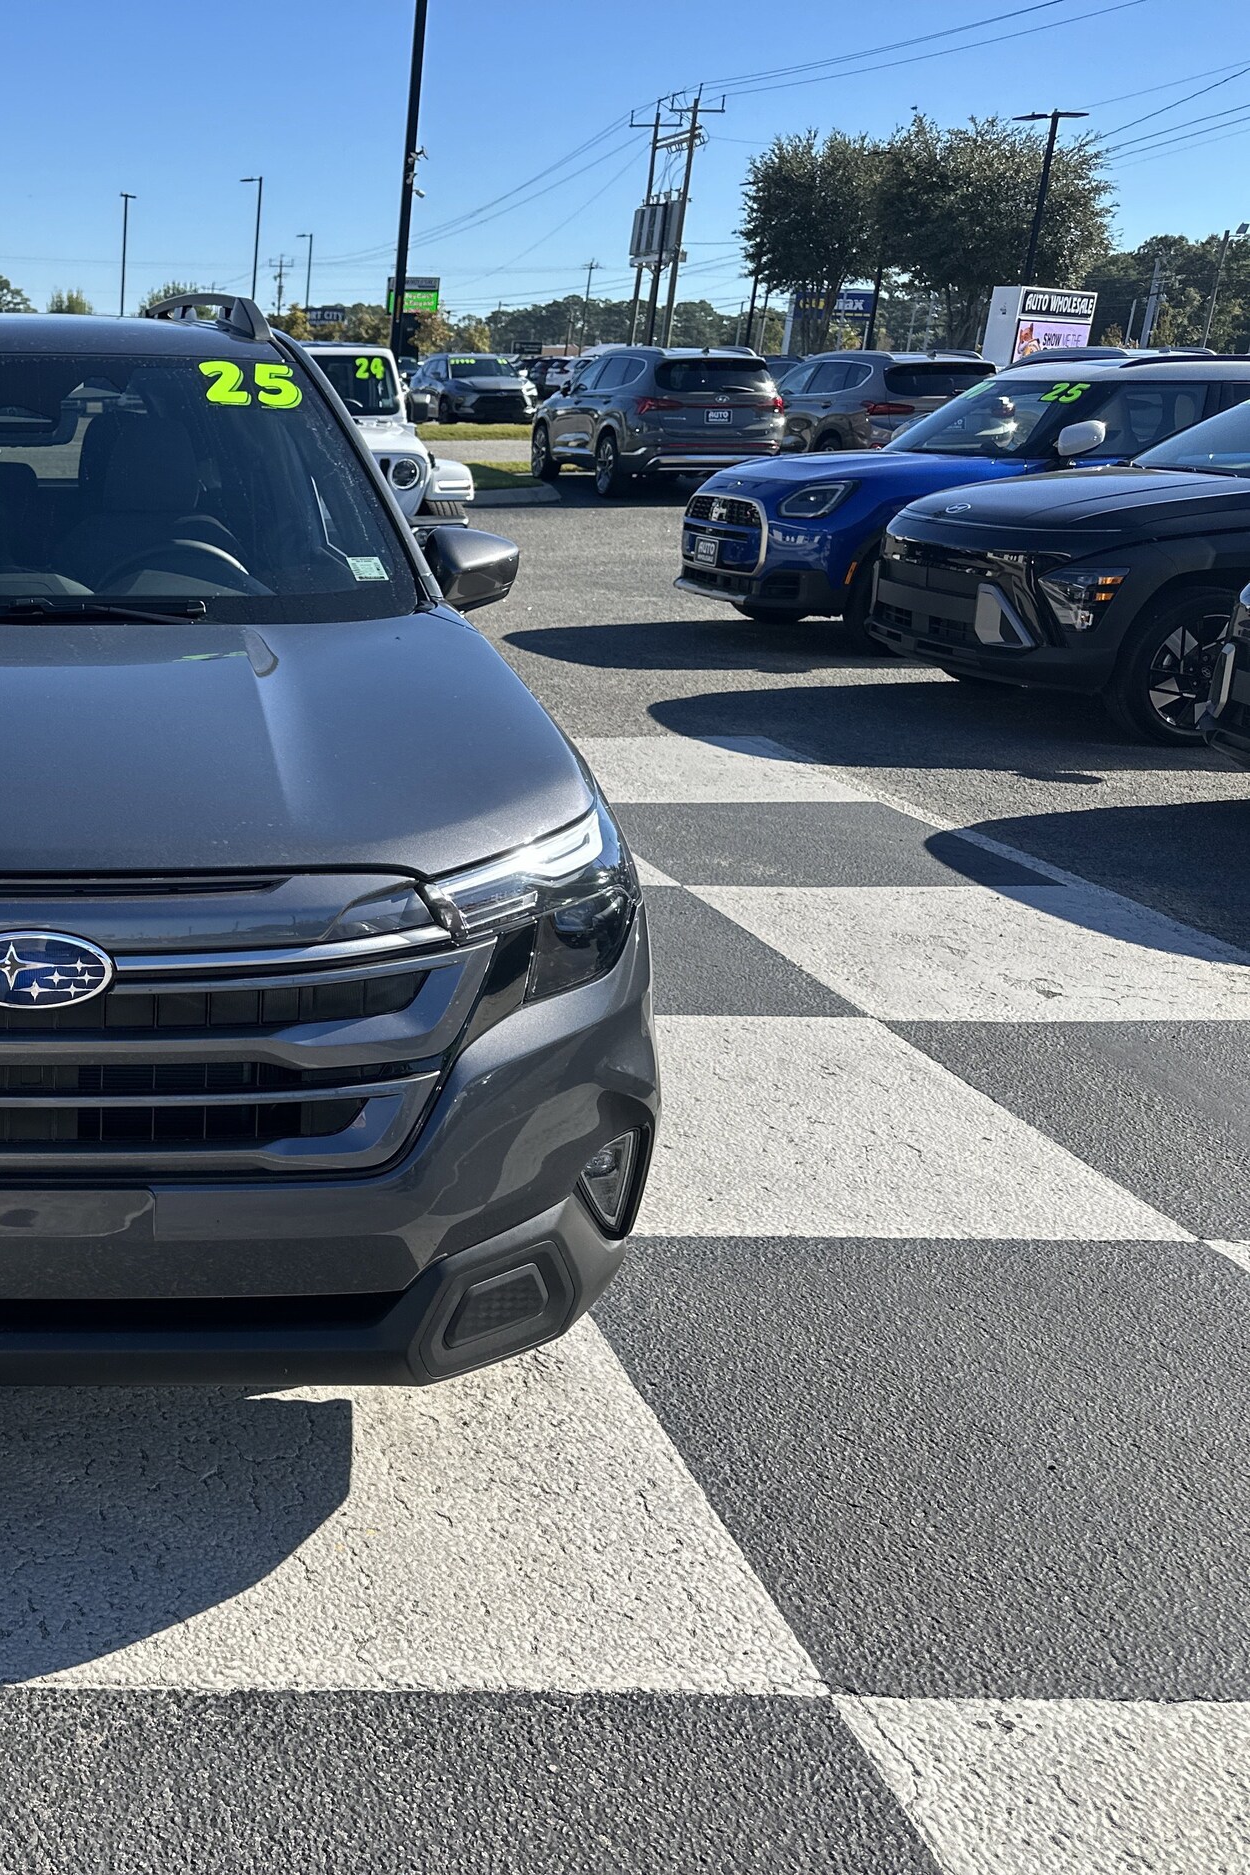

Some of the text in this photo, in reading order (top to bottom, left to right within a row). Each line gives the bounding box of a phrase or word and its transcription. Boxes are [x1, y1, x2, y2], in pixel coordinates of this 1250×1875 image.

[1025, 293, 1094, 315] AUTO WHOLESALE
[323, 311, 343, 321] CITY
[1042, 333, 1062, 347] SHOW
[355, 357, 385, 380] 24
[198, 361, 303, 409] 25
[1040, 382, 1091, 404] 25
[708, 411, 729, 419] AUTO
[698, 541, 715, 555] AUTO
